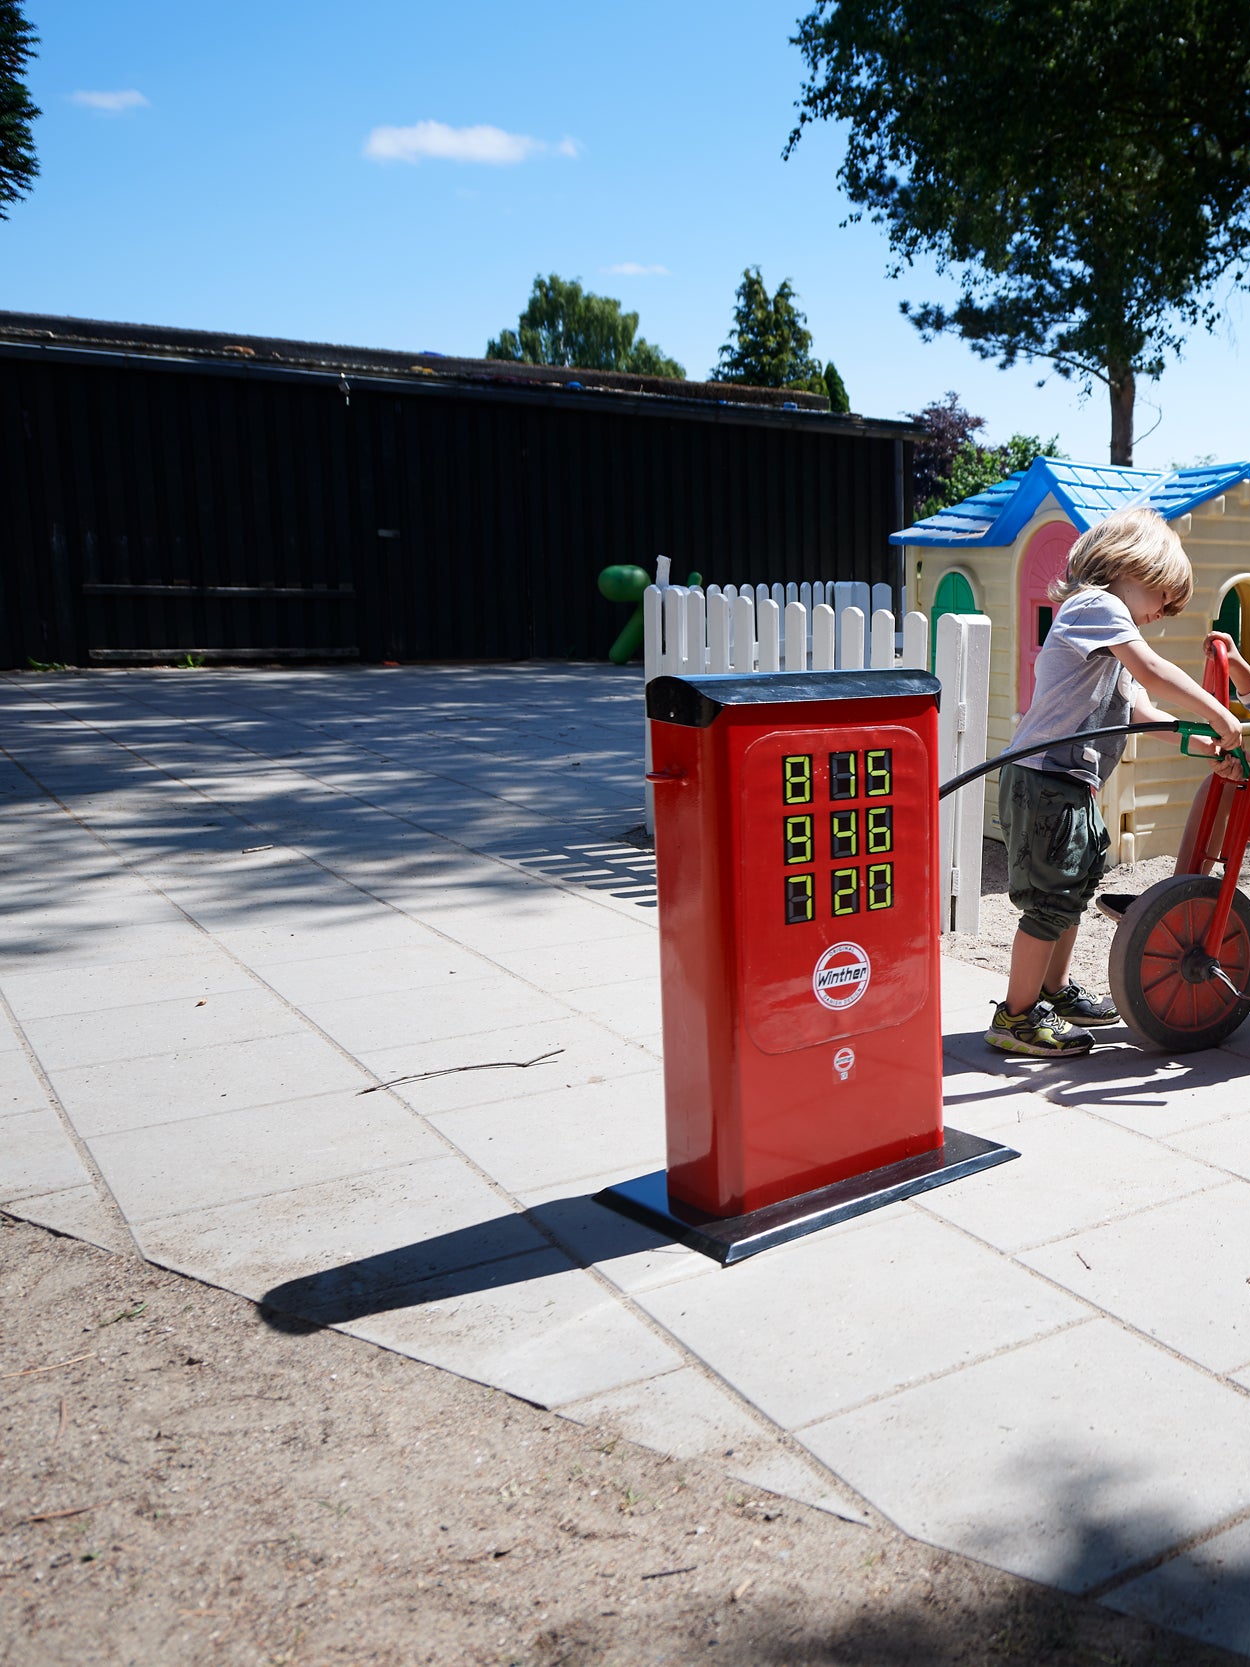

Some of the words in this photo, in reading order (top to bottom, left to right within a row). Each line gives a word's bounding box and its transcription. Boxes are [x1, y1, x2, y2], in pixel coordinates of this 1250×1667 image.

[785, 755, 811, 804] 8
[845, 750, 891, 798] 15
[786, 815, 812, 864] 9
[833, 807, 891, 856] 46
[787, 875, 813, 920] 7
[834, 863, 891, 916] 20
[818, 967, 867, 987] Winther
[829, 946, 855, 956] ORIGINAL
